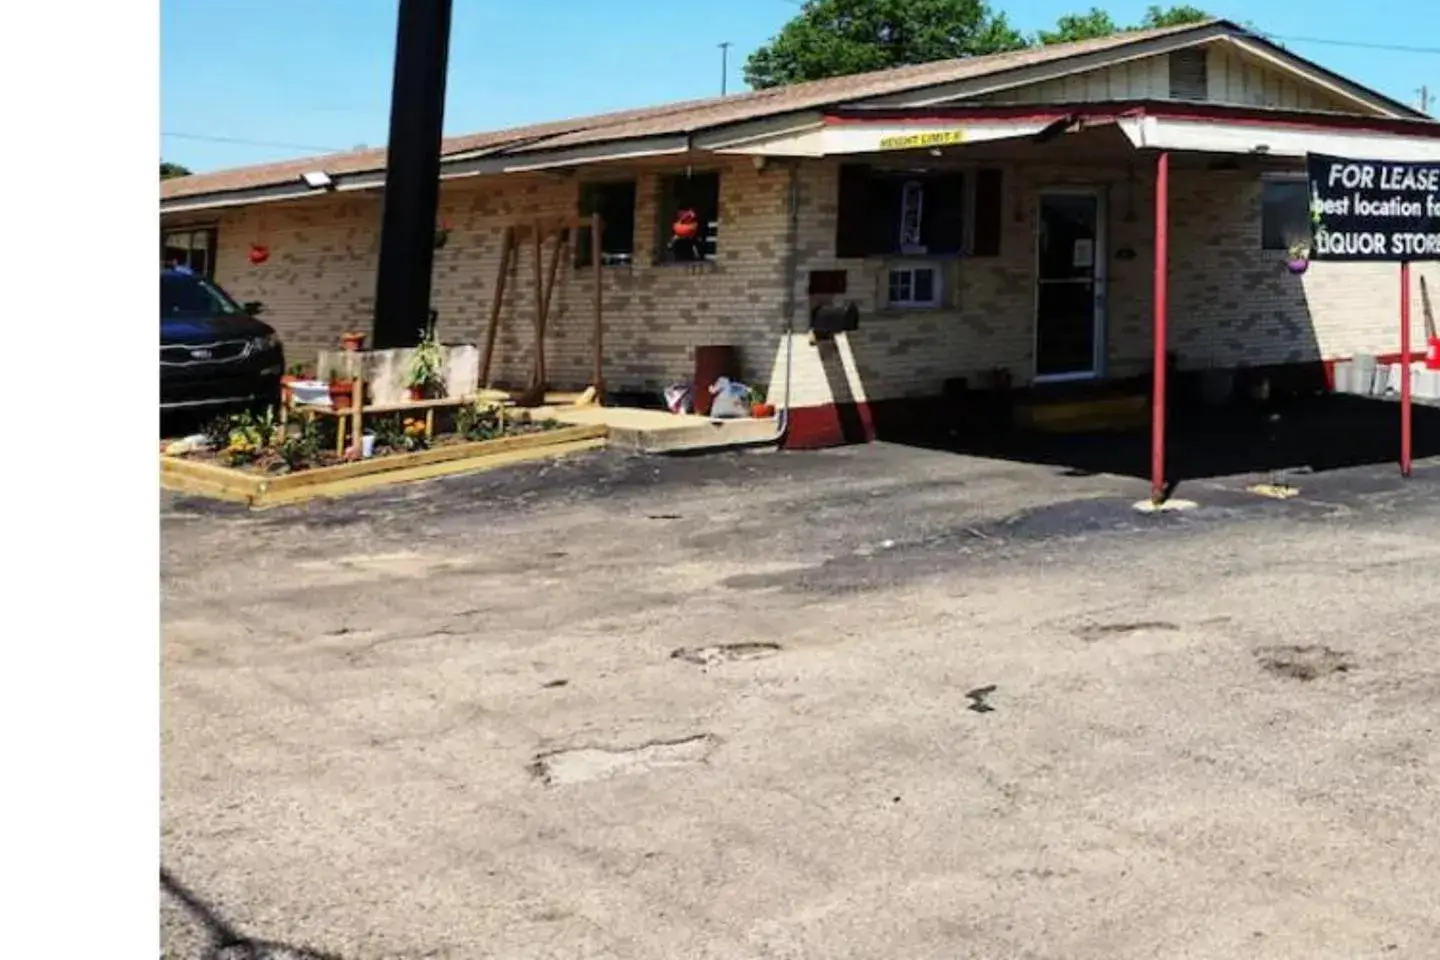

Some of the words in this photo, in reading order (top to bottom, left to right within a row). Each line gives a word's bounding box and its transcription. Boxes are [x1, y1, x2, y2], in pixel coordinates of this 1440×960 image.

[1328, 163, 1375, 189] FOR
[1380, 166, 1440, 191] LEASE
[1354, 192, 1422, 217] location
[1315, 231, 1387, 254] LIQUOR
